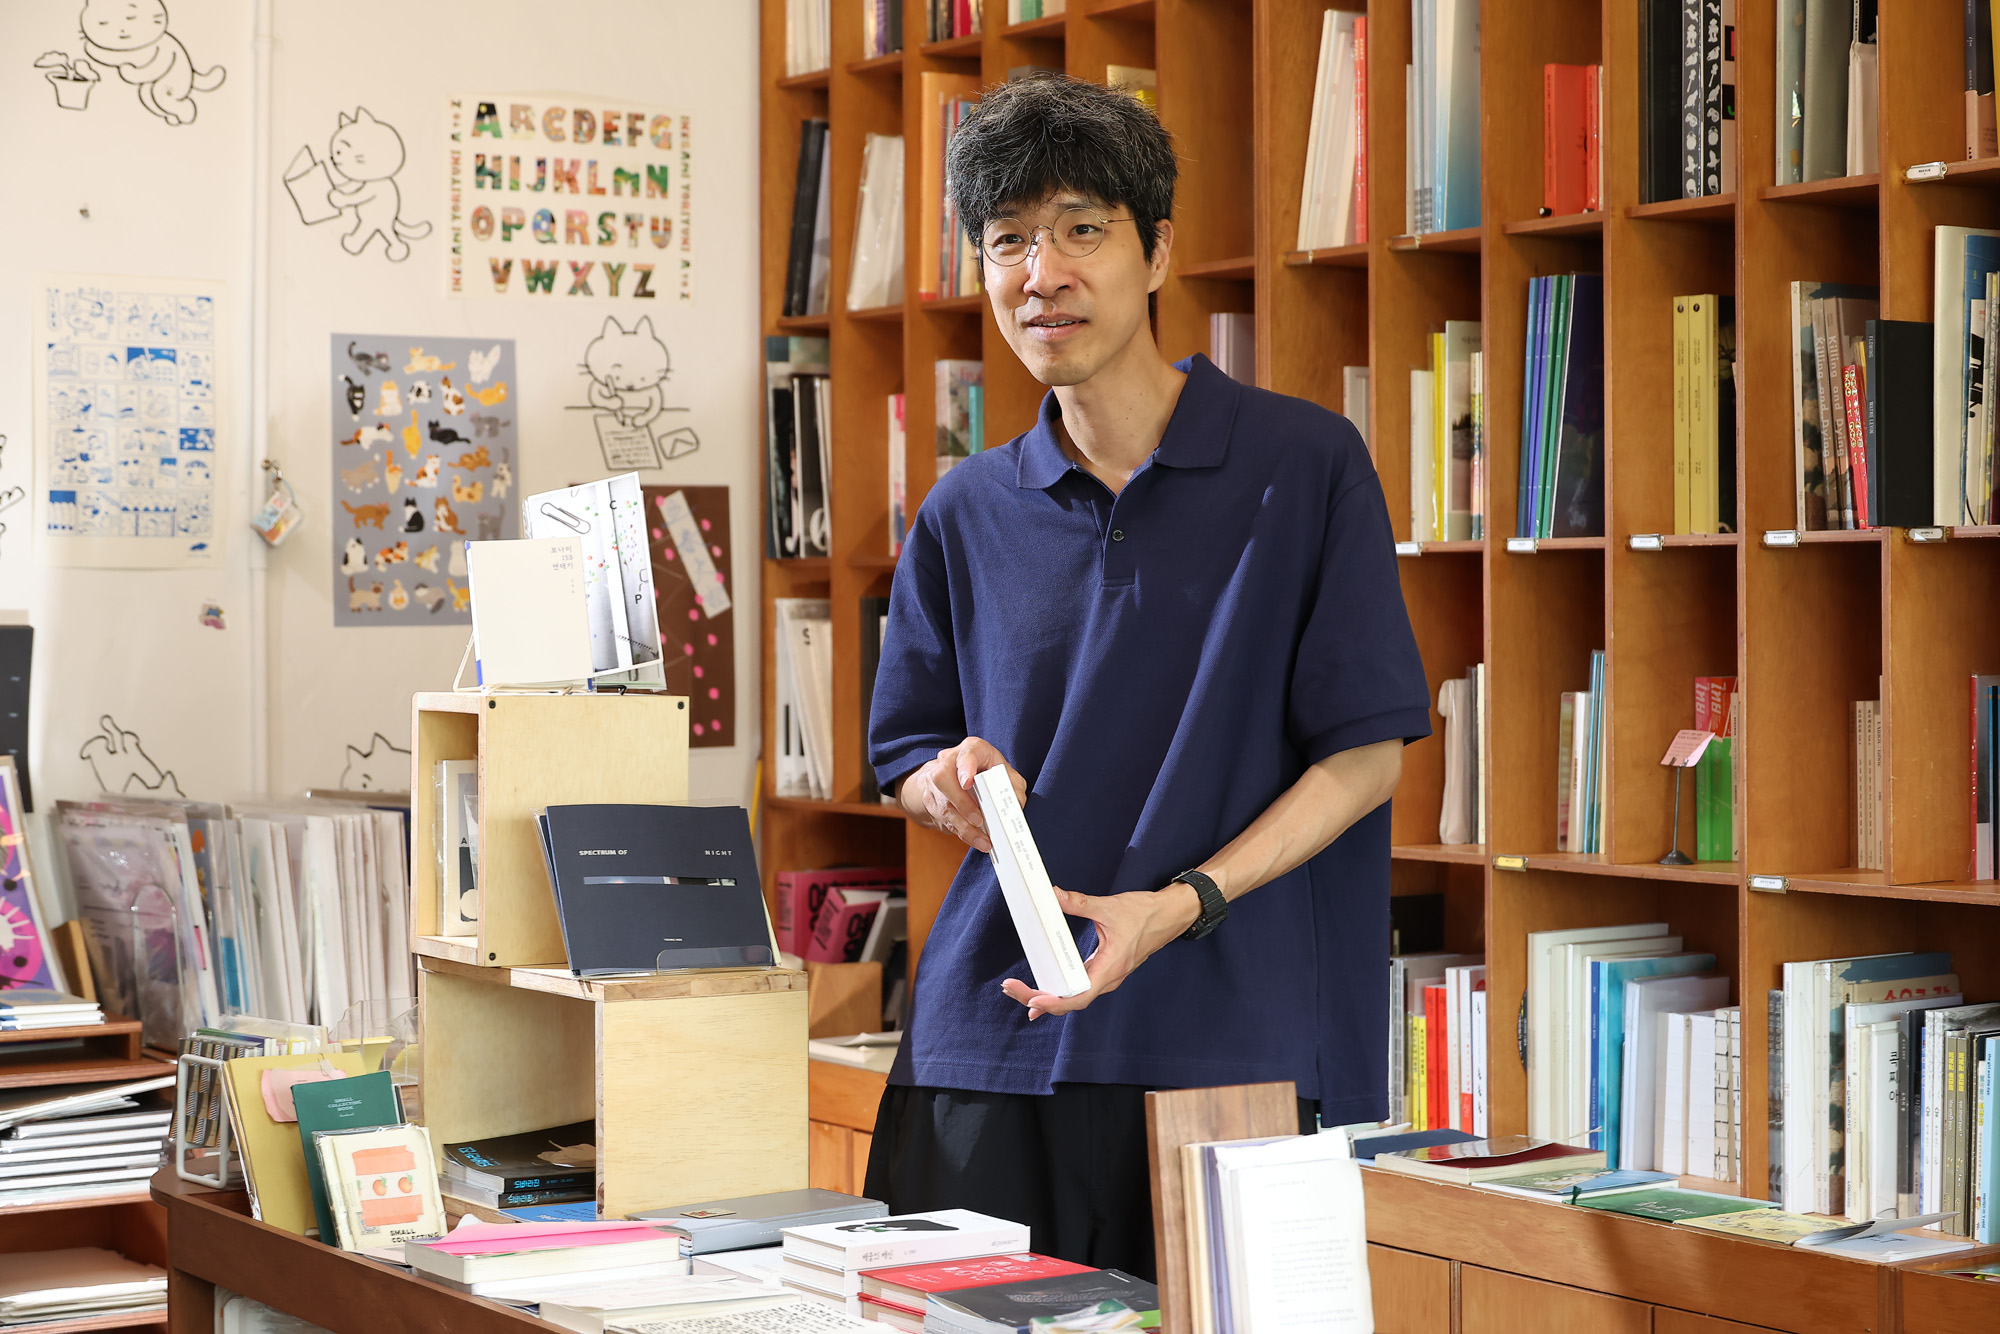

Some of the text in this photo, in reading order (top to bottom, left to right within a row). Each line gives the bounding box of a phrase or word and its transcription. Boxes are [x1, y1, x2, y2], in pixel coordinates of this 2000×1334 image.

[1814, 337, 1832, 458] Killing and Dying
[1827, 335, 1846, 457] Killing and Dying
[617, 848, 628, 856] OF
[390, 1228, 416, 1237] SMALL
